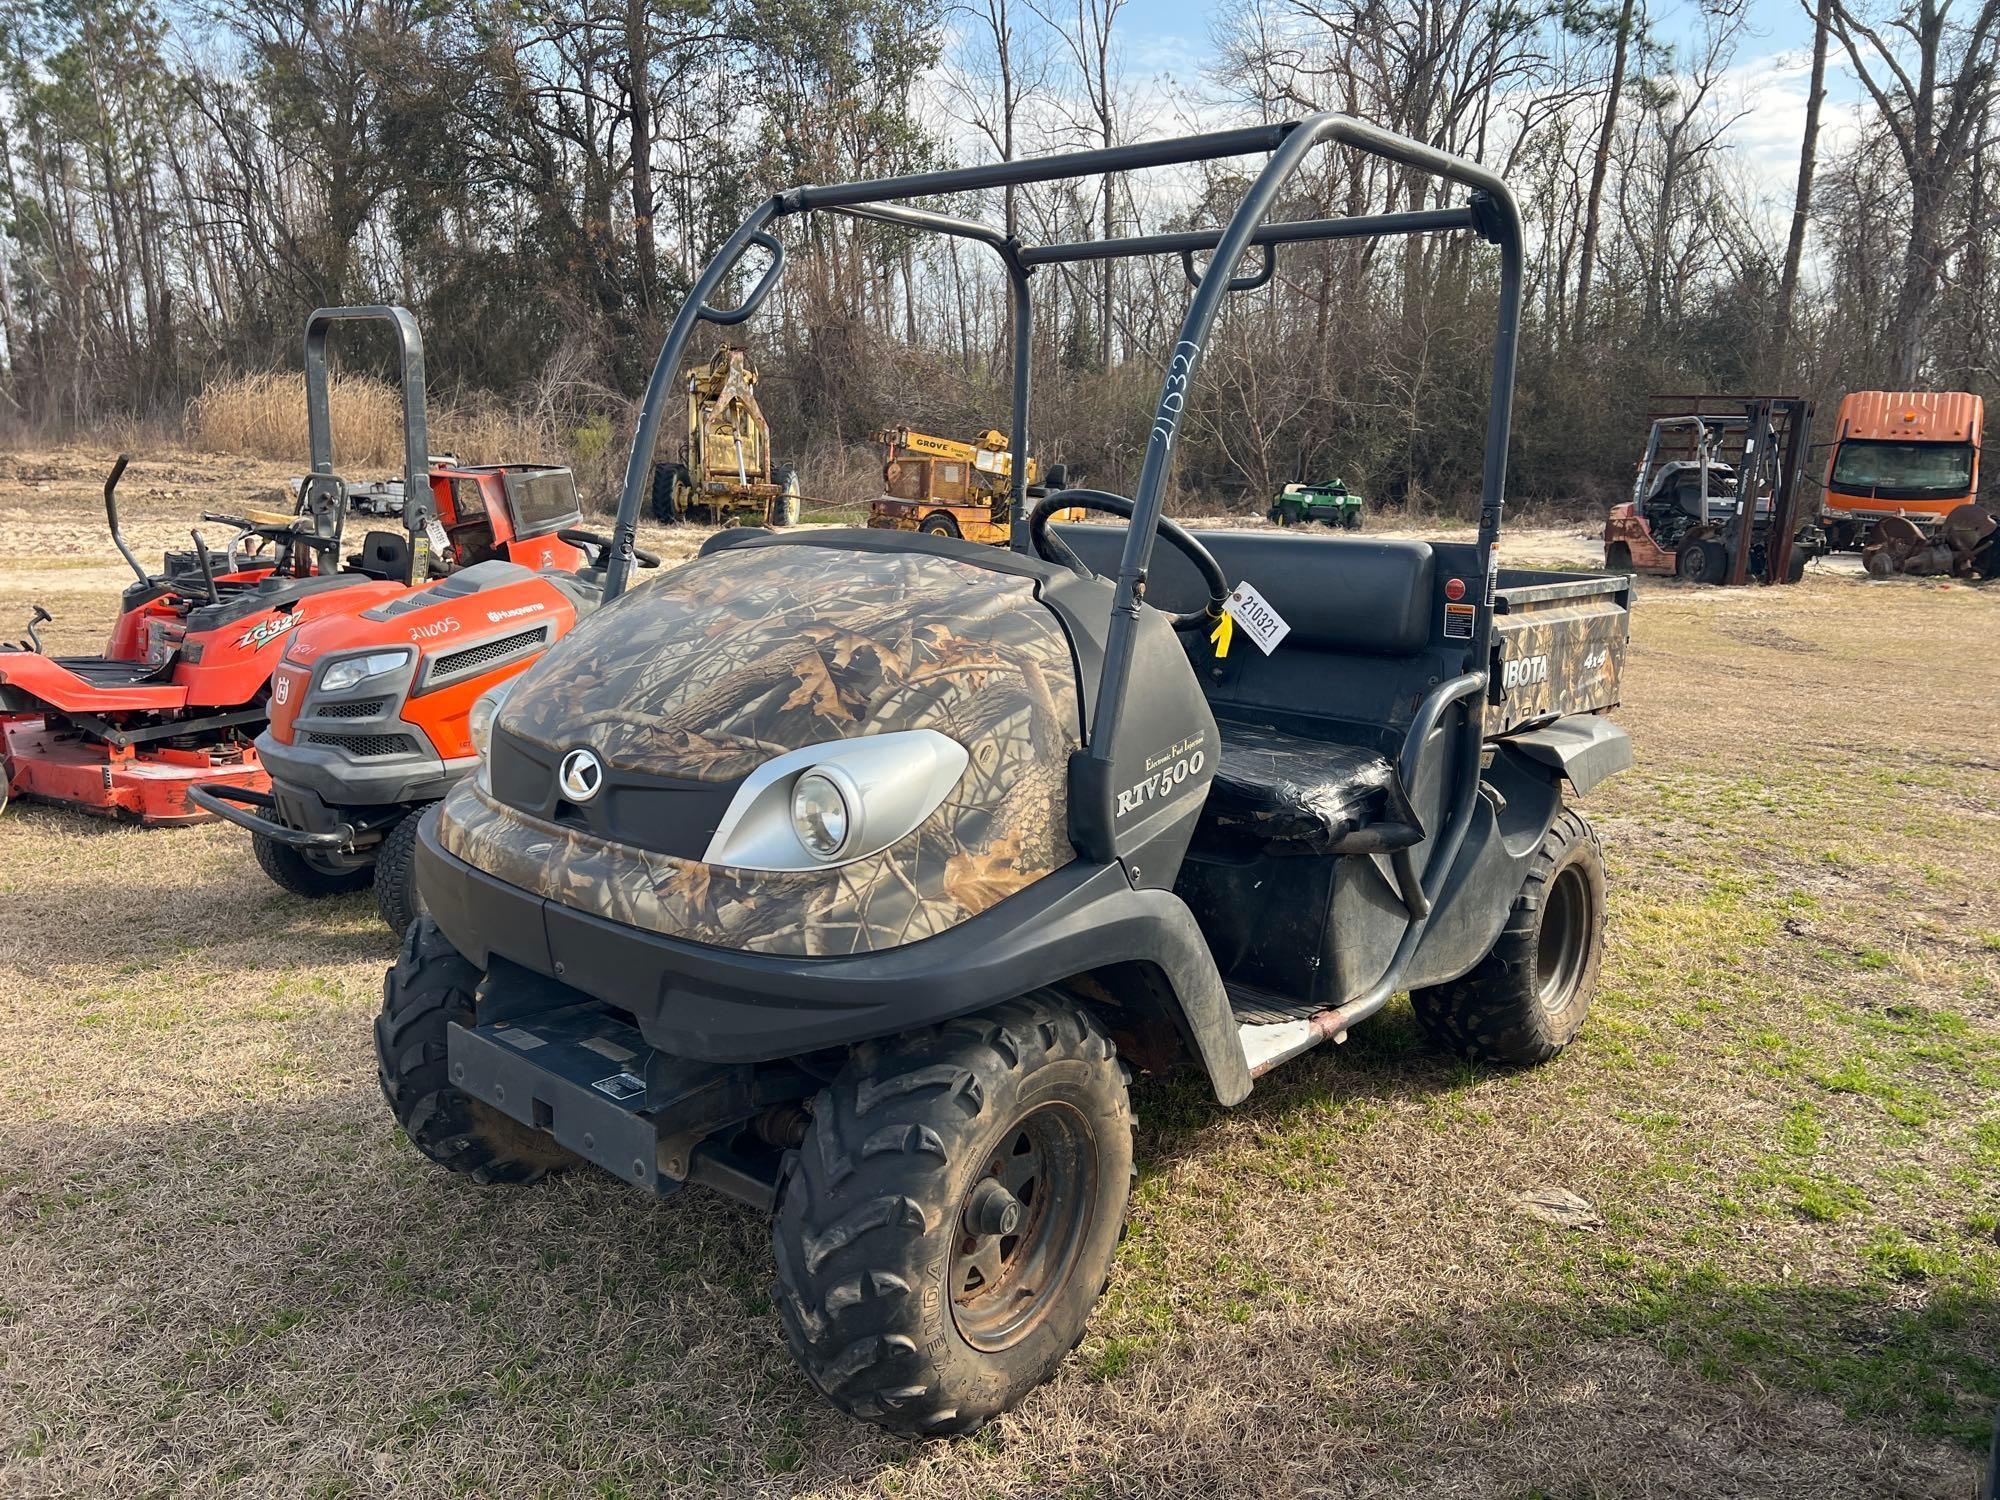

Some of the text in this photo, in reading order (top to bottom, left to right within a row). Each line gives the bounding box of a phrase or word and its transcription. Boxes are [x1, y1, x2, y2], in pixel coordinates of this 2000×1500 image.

[1152, 340, 1201, 451] 210321
[916, 438, 949, 451] GROVE
[498, 602, 545, 619] Husqvarna
[1241, 595, 1279, 638] 210321
[237, 608, 306, 650] ZG327
[408, 616, 461, 640] 211005
[1583, 649, 1607, 670] 4x4
[1145, 754, 1172, 771] Electronic
[1172, 744, 1184, 758] Fuel
[1116, 750, 1205, 818] RTV500
[923, 1258, 957, 1380] KENDA
